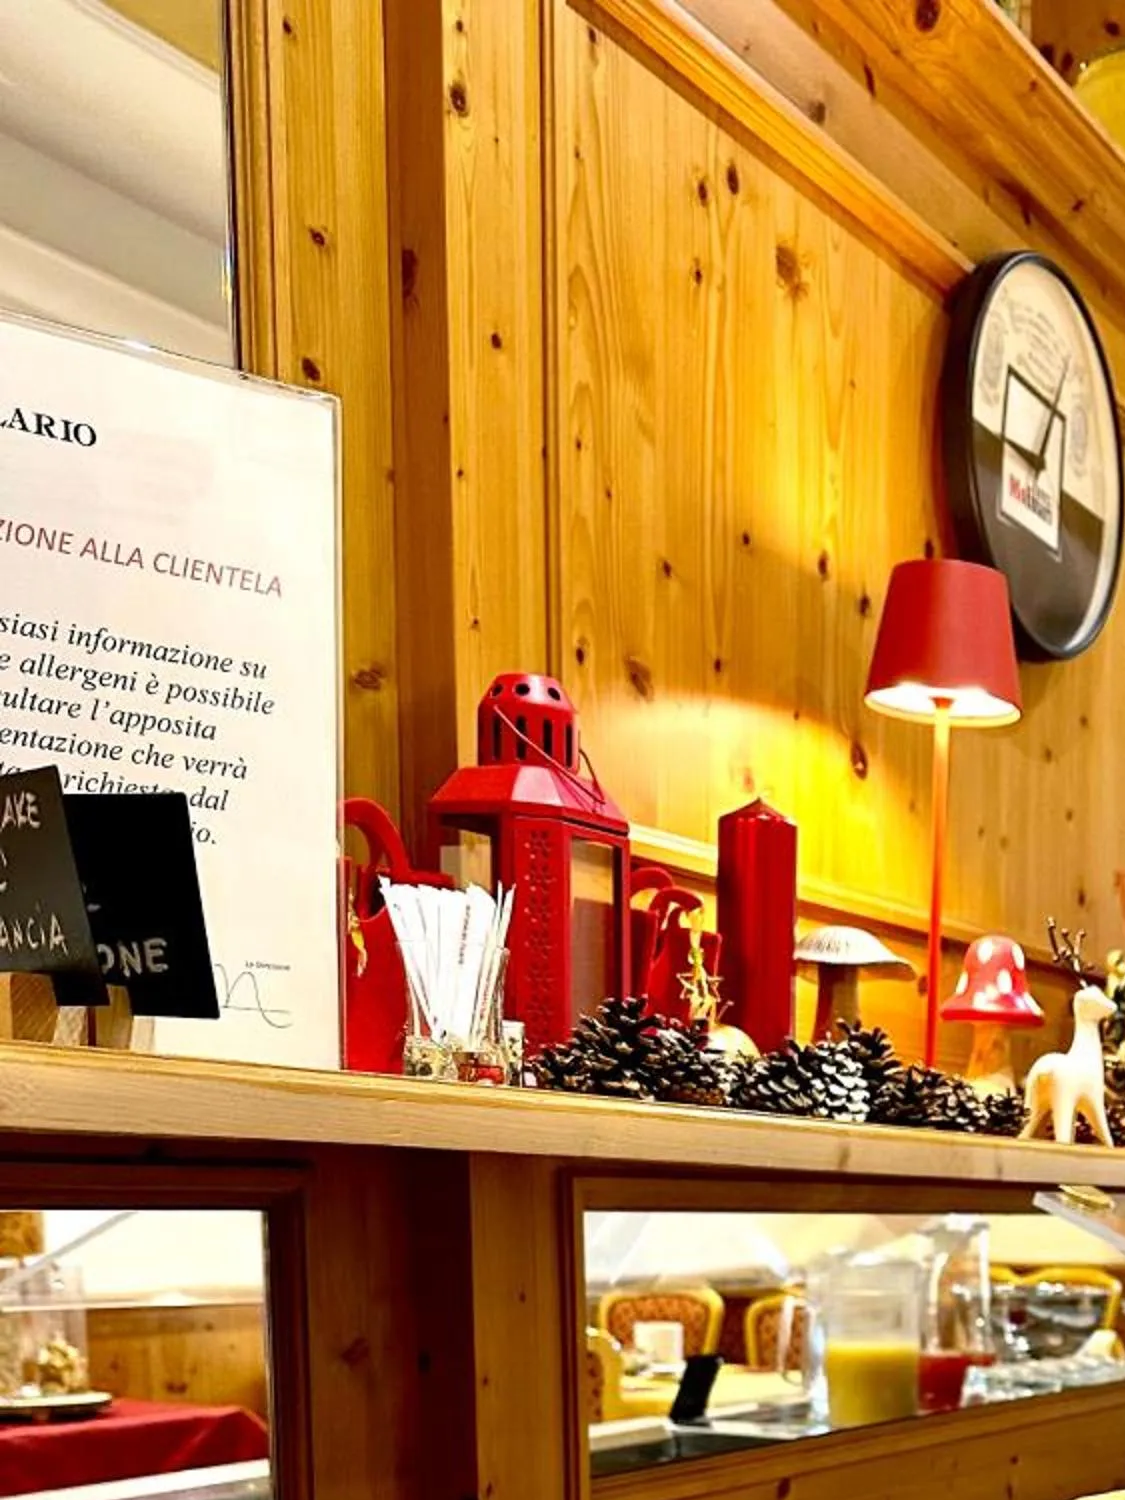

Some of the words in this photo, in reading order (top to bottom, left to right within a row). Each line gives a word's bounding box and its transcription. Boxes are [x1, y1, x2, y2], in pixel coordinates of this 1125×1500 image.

[0, 407, 97, 447] ARIO
[79, 537, 144, 569] ALLA
[153, 552, 282, 598] CLIENTELA
[0, 613, 60, 642] siasi
[67, 623, 233, 673] informazione
[239, 661, 267, 679] su
[19, 653, 138, 692] allergeni
[145, 672, 159, 696] è
[164, 683, 275, 715] possibile
[0, 687, 82, 719] ultare
[90, 698, 217, 741] l'apposita
[0, 727, 123, 761] entazione
[131, 744, 175, 769] che
[182, 757, 248, 780] verrà
[63, 770, 175, 794] richiest
[189, 786, 229, 811] dal
